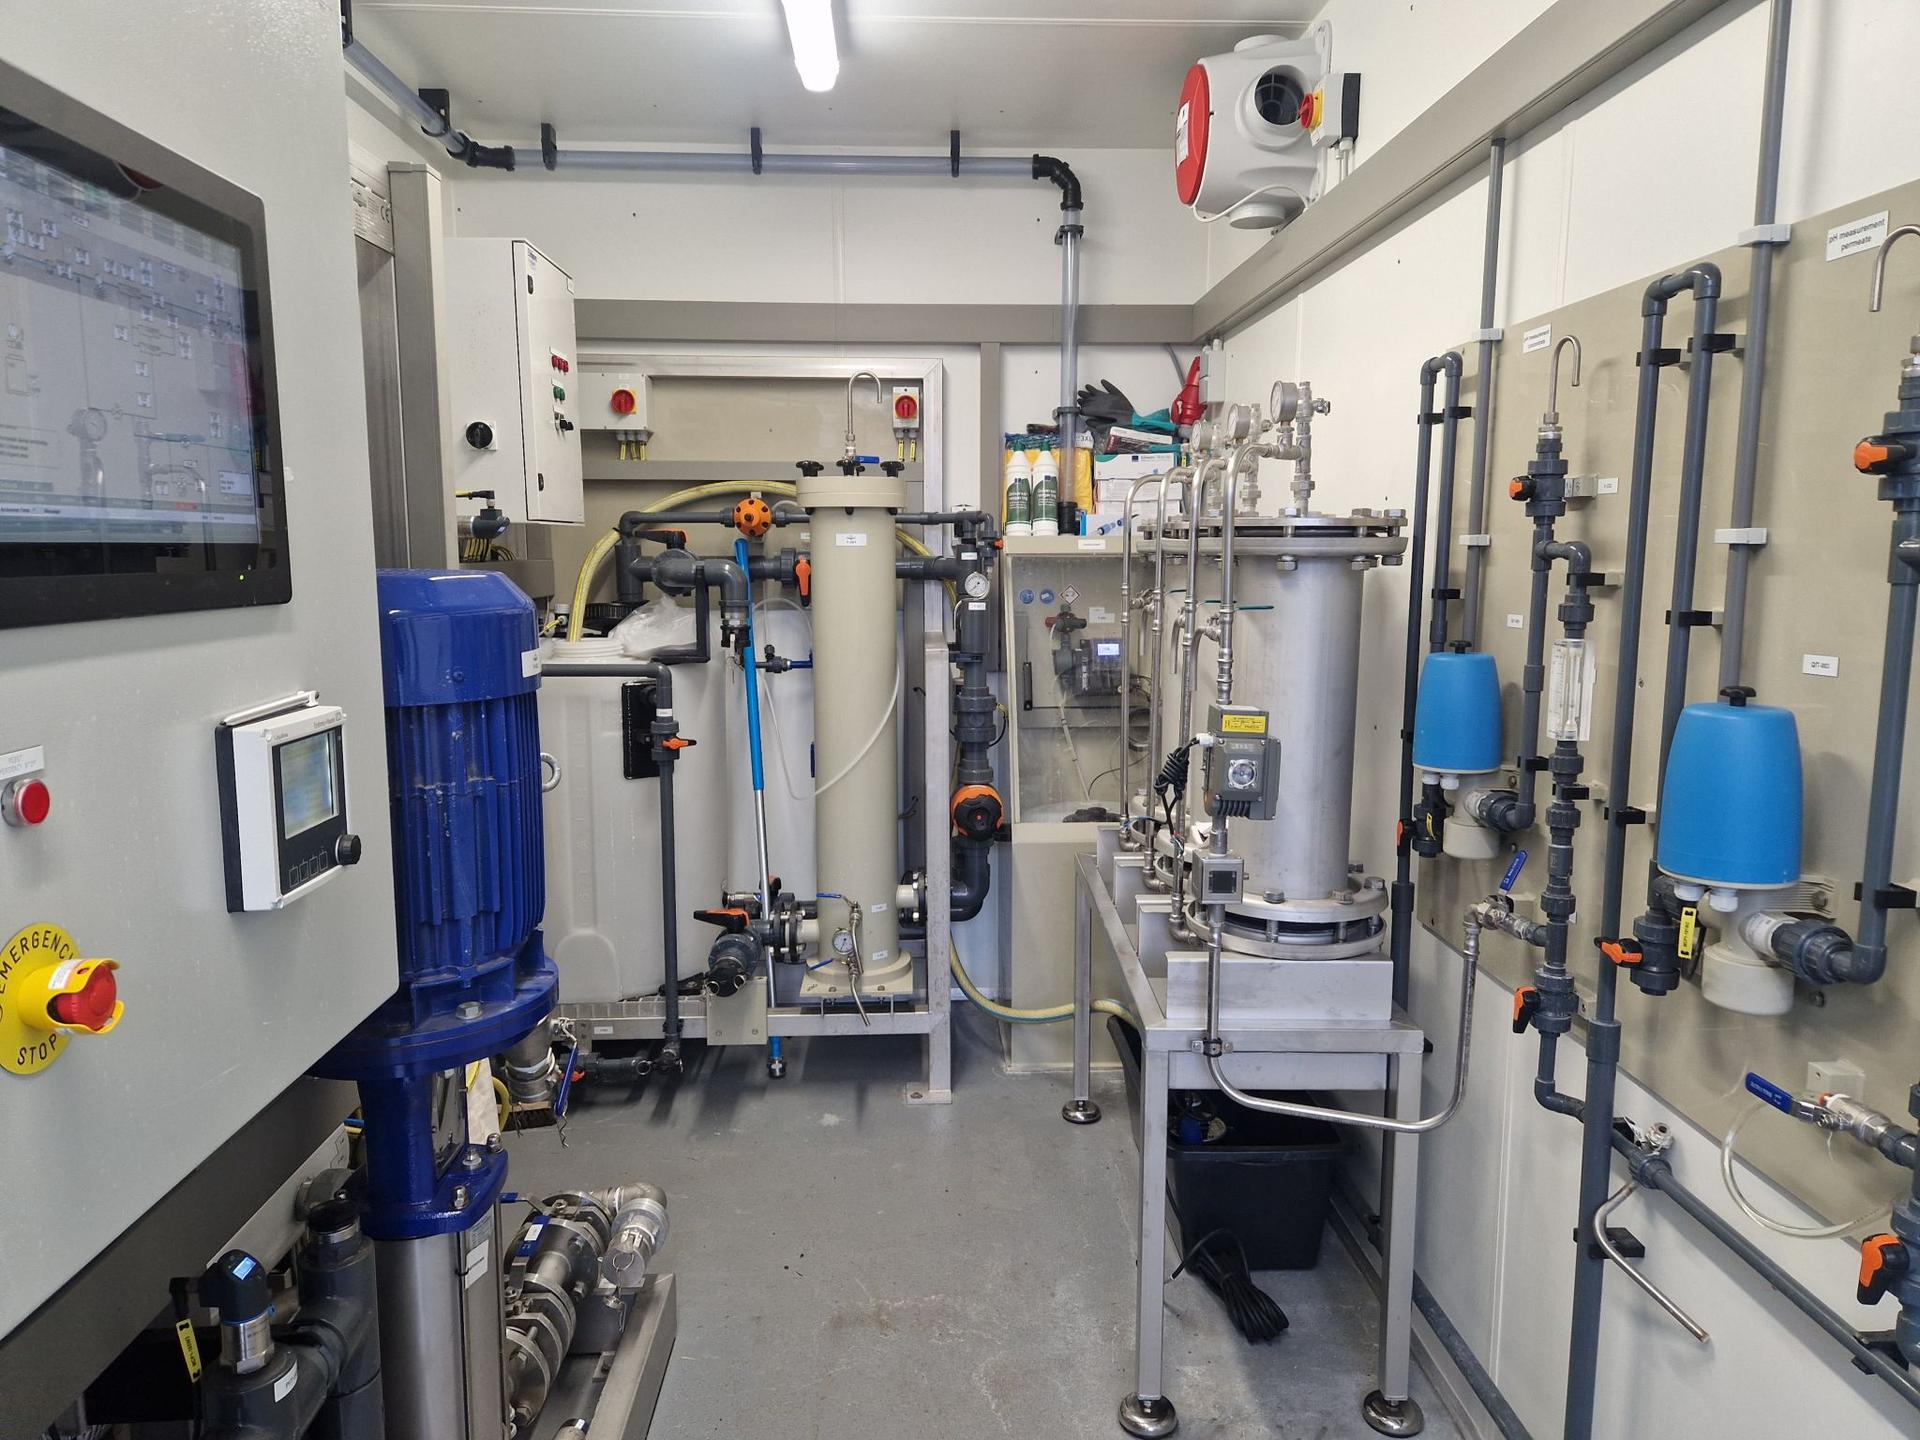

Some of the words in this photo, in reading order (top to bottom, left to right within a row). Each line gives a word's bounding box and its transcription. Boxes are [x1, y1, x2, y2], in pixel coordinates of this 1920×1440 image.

[1828, 232, 1839, 244] pH
[1839, 218, 1885, 240] measurement
[1841, 235, 1872, 252] permeate
[17, 1032, 58, 1067] STOP
